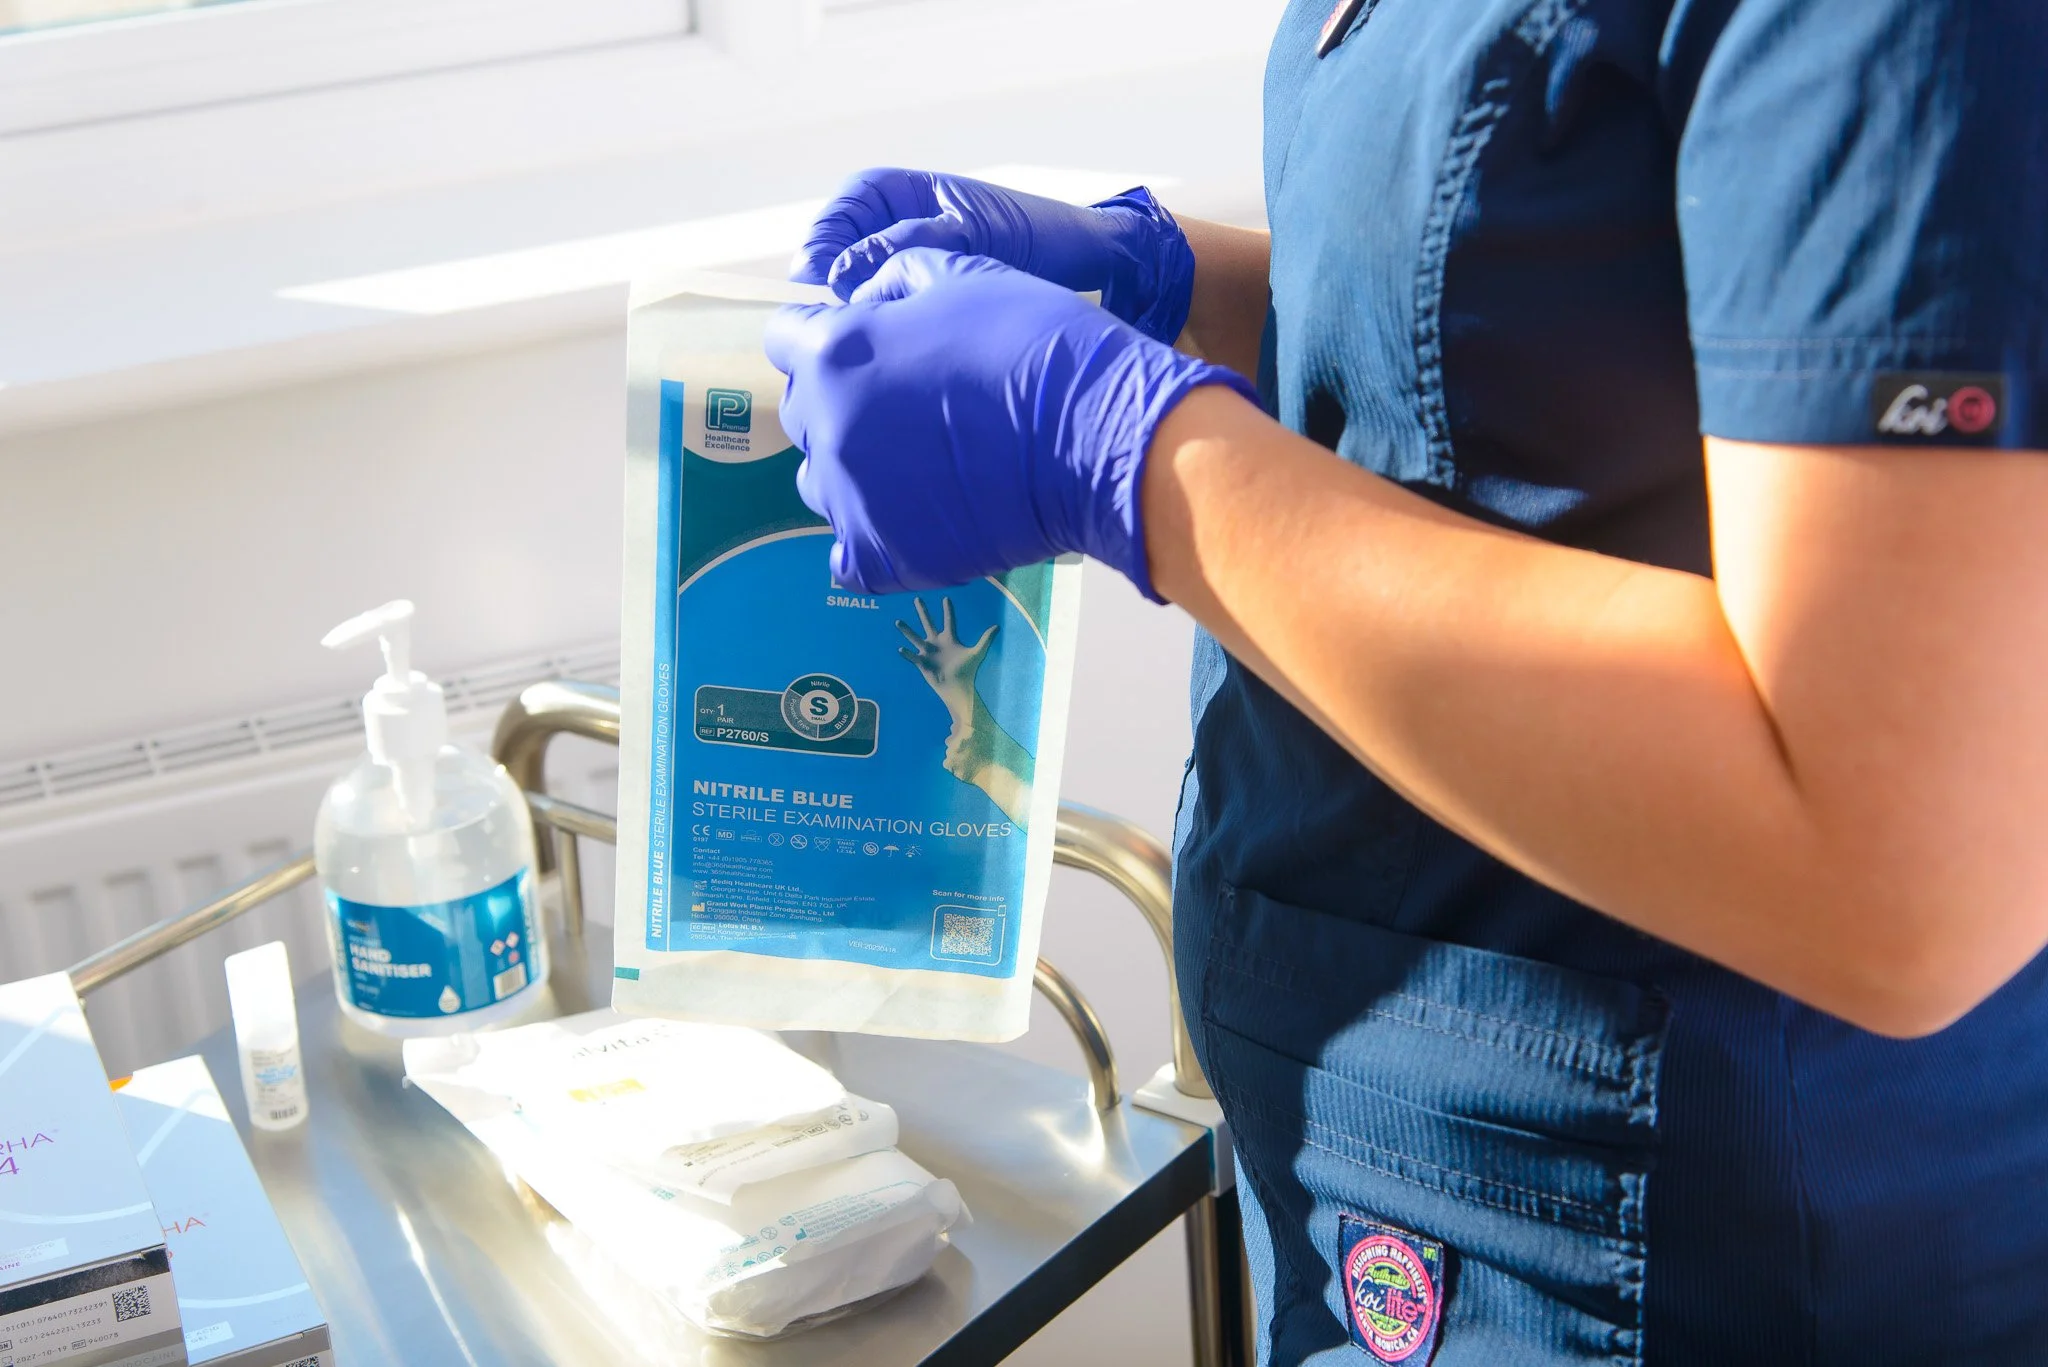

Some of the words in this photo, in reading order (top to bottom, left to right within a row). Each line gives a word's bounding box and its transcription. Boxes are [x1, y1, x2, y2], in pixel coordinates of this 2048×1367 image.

[721, 422, 749, 432] Premier
[704, 441, 750, 452] Excellence
[705, 433, 750, 445] Healthcare
[826, 595, 880, 610] SMALL
[657, 663, 670, 712] GLOVES
[810, 680, 830, 688] Nitrile
[717, 703, 725, 716] 1
[809, 696, 829, 716] S
[717, 716, 734, 724] PAIR
[789, 698, 799, 720] Powder
[797, 719, 810, 731] Free
[834, 713, 849, 730] Blue
[716, 728, 770, 742] P2760/S
[656, 716, 668, 797] EXAMINATION
[693, 780, 785, 802] NITRILE
[792, 790, 853, 809] BLUE
[654, 798, 666, 848] STERILE
[692, 802, 777, 823] STERILE
[784, 811, 922, 836] EXAMINATION
[929, 822, 1012, 838] GLOVES
[717, 831, 733, 839] MD
[653, 850, 664, 885] BLUE
[711, 879, 732, 887] Mediq
[734, 880, 773, 889] Healthcare
[711, 886, 735, 894] George
[691, 890, 724, 898] Millmarsh
[932, 889, 953, 897] Scan
[954, 890, 965, 898] for
[989, 894, 1005, 902] info
[651, 887, 663, 938] NITRILE
[707, 907, 737, 915] Donggao
[749, 903, 773, 911] Plastic
[774, 904, 806, 914] Products
[718, 921, 739, 929] Lotus
[350, 942, 392, 963] HAND
[351, 956, 433, 979] SANITISER
[0, 1132, 54, 1155] HA
[1351, 1244, 1389, 1278] DESIGNING
[1389, 1246, 1428, 1304] HAPPINESS
[1355, 1275, 1385, 1312] koi
[1385, 1287, 1419, 1323] lite
[1356, 1305, 1374, 1340] SANTA
[1407, 1327, 1421, 1342] CA
